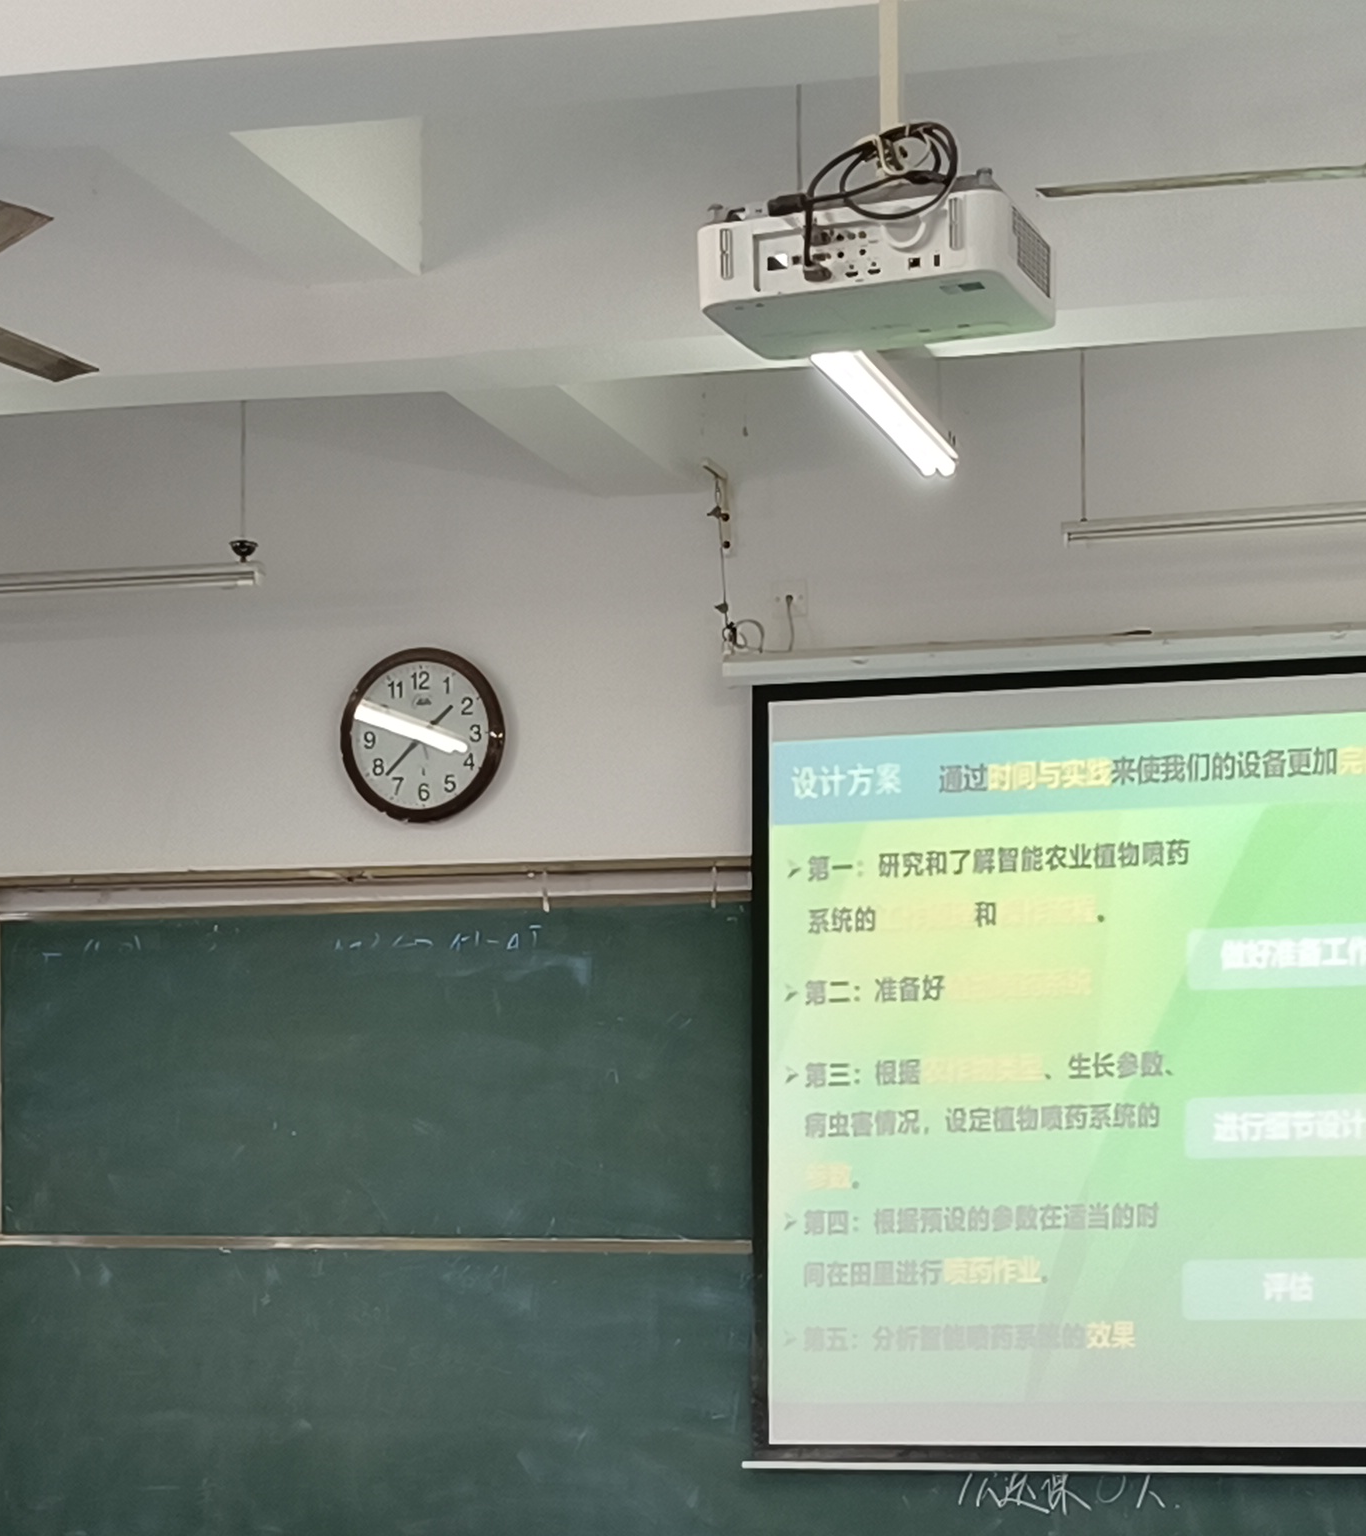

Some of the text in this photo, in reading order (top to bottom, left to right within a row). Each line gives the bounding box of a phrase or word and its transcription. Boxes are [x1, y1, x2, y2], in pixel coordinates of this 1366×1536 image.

[388, 681, 404, 699] 11
[411, 671, 430, 690] 12
[443, 676, 451, 694] 1
[461, 697, 474, 716] 2
[363, 731, 376, 749] 9
[469, 724, 482, 743] 3
[372, 758, 385, 776] 8
[463, 753, 475, 771] 4
[391, 777, 404, 796] 7
[444, 774, 456, 793] 5
[791, 763, 902, 799] 设计方案
[418, 783, 430, 801] 6
[1263, 1272, 1314, 1302] 评估
